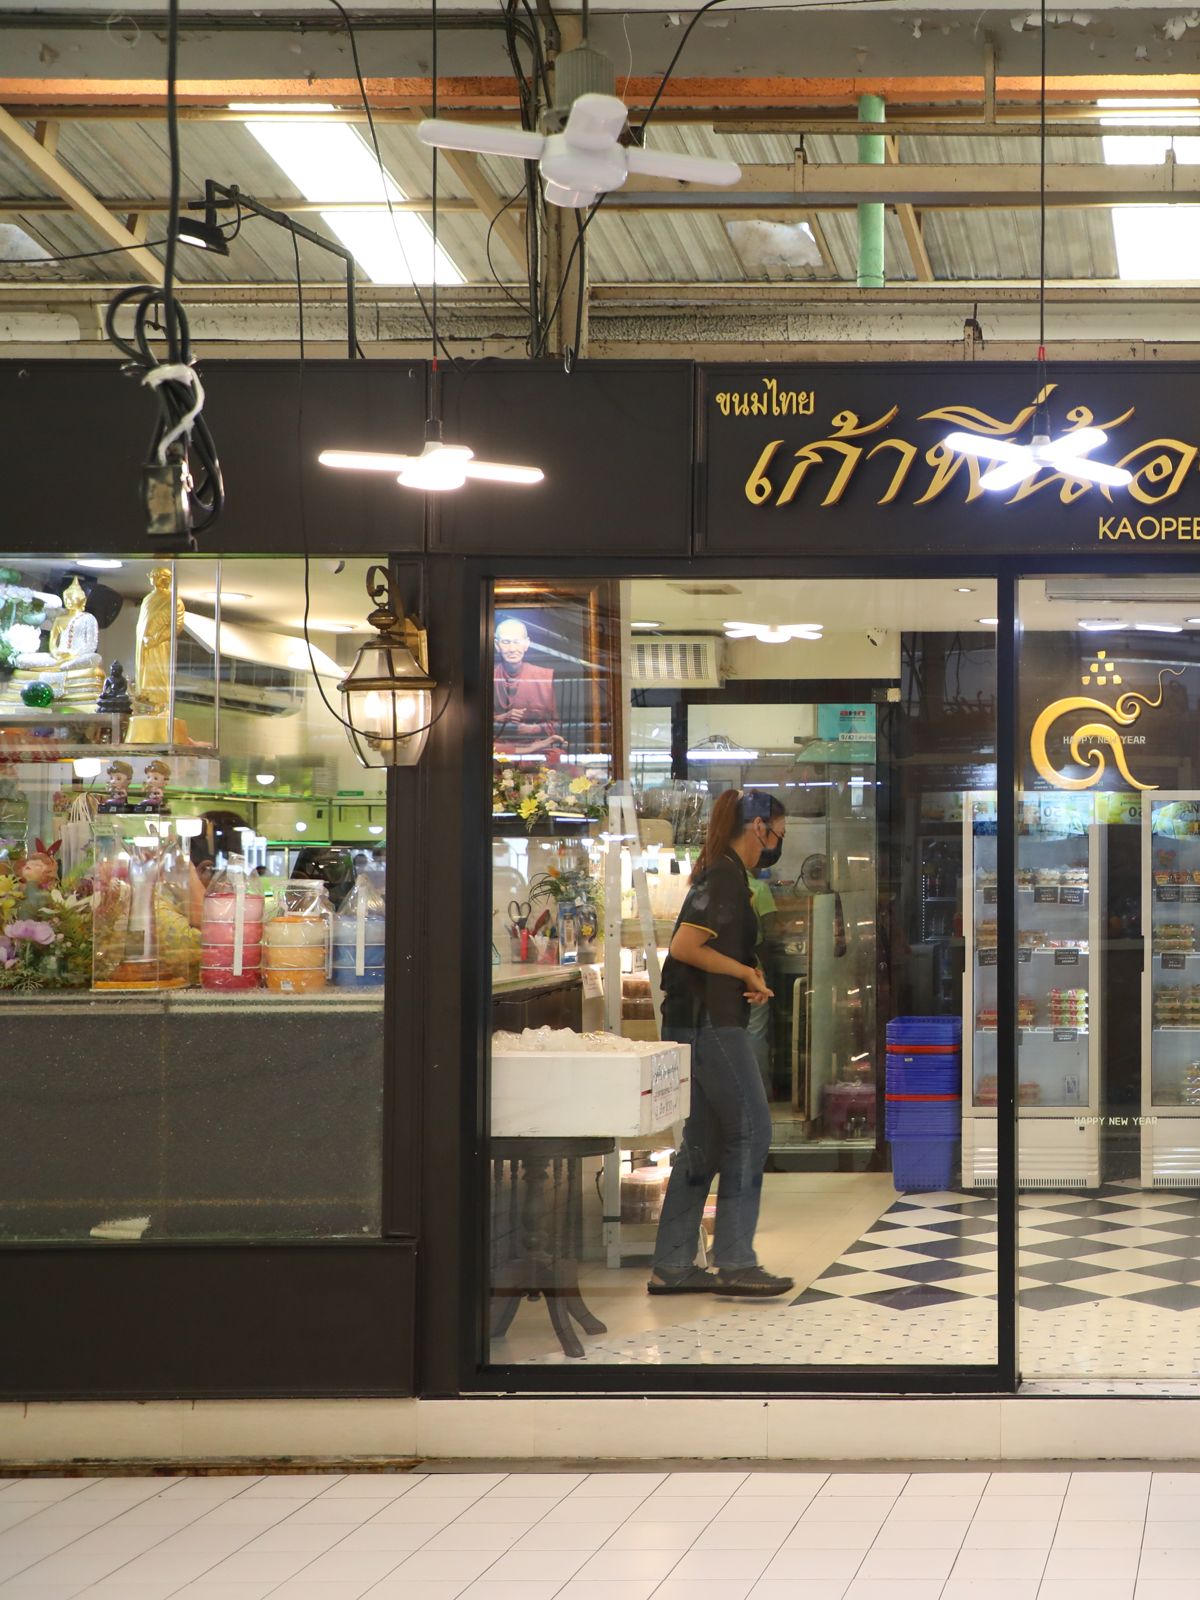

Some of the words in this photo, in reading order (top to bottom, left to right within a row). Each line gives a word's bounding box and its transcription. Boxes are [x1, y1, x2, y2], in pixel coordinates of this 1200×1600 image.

[716, 378, 815, 416] ขนมไทย
[1122, 736, 1146, 745] YEAR
[1074, 1117, 1106, 1126] HAPPY
[1108, 1117, 1129, 1126] NEW
[1132, 1117, 1158, 1126] YEAR
